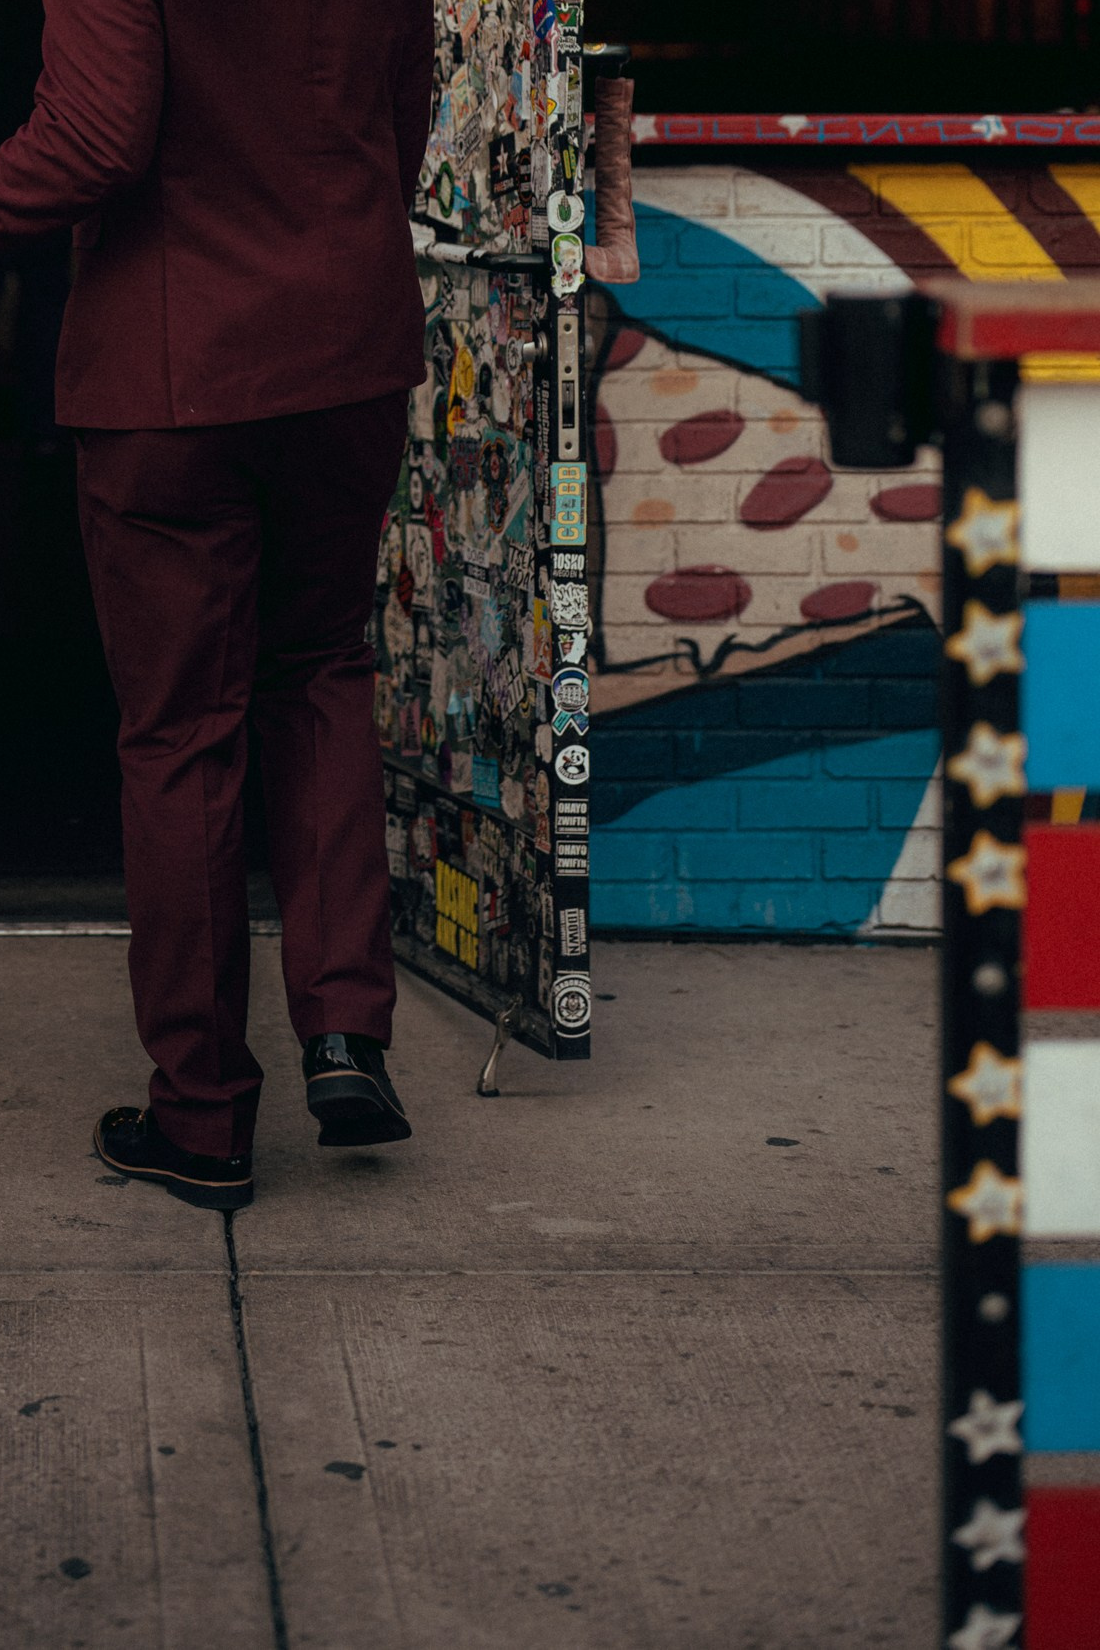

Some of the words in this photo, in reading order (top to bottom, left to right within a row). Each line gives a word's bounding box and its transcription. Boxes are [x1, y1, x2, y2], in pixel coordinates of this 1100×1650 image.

[558, 802, 588, 814] OHAYO
[557, 815, 587, 827] ZWIFTR
[558, 844, 588, 856] OHAYO
